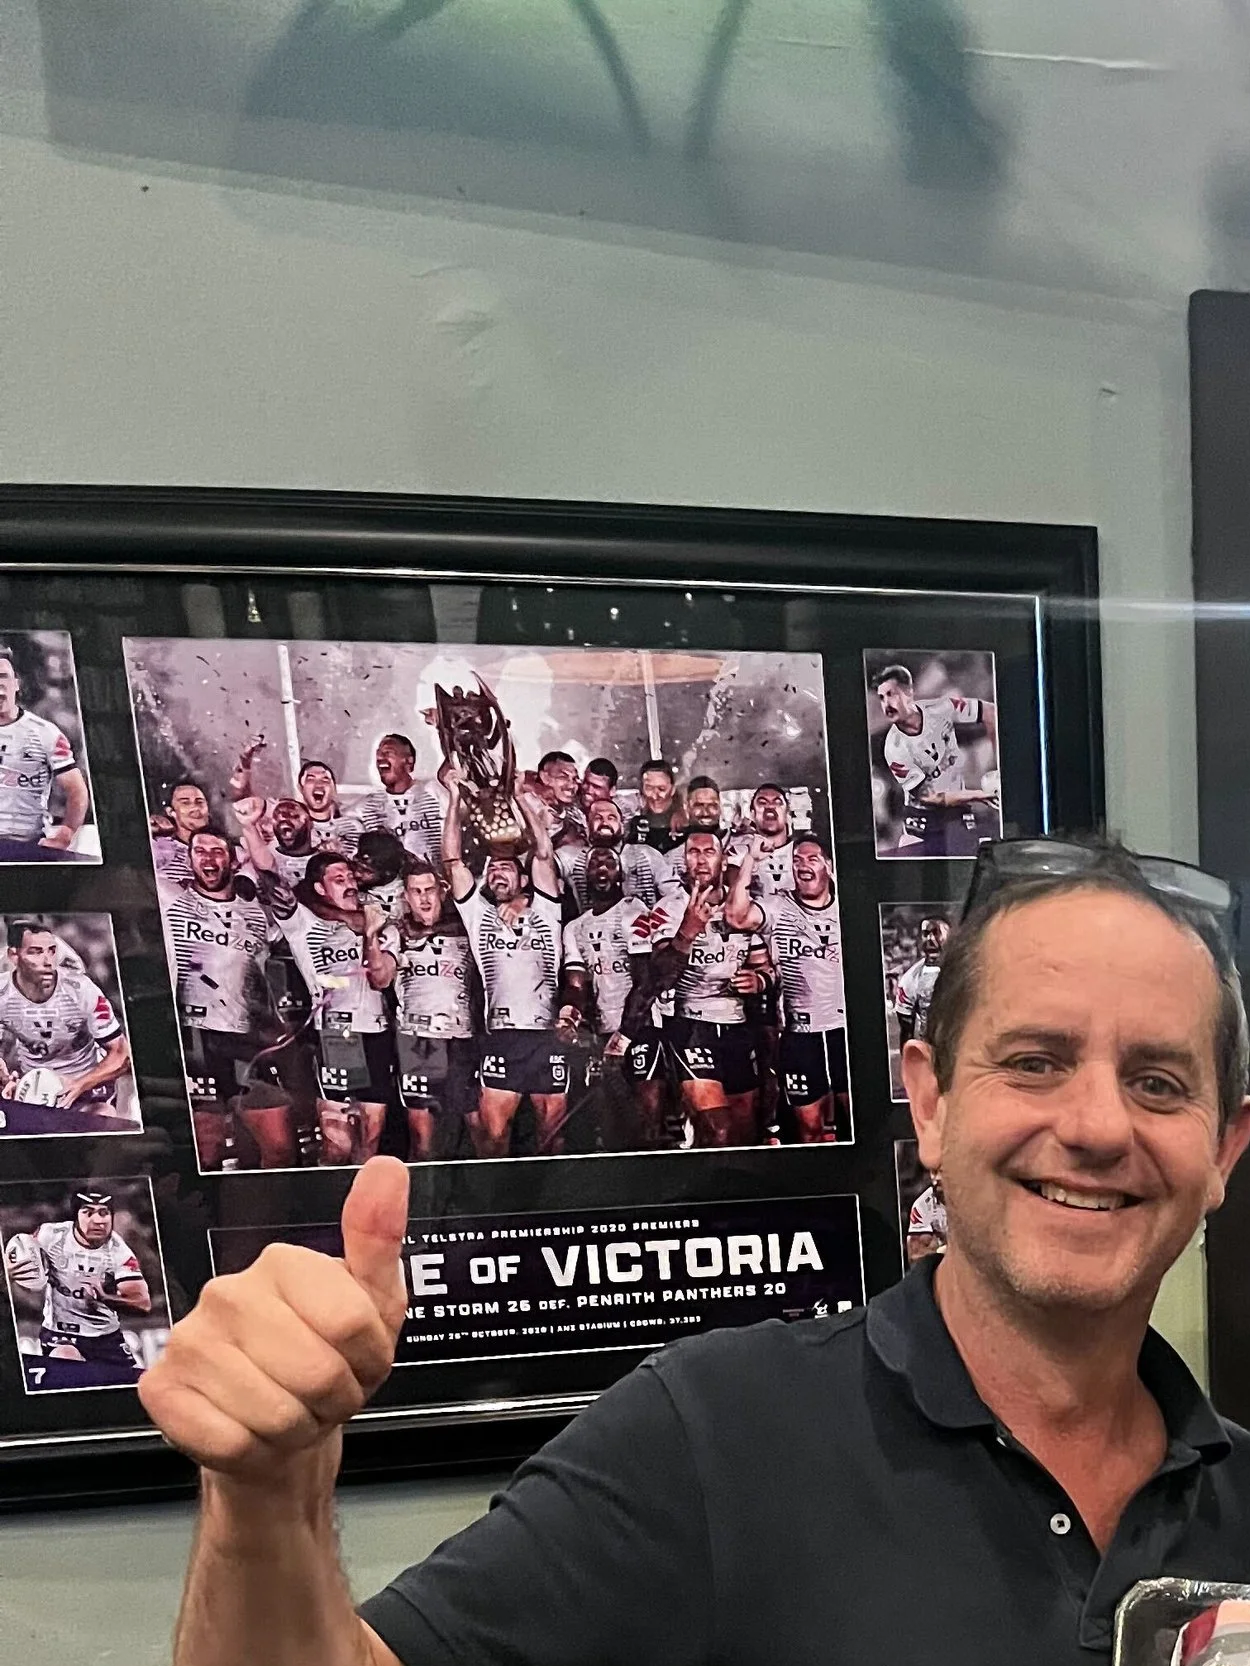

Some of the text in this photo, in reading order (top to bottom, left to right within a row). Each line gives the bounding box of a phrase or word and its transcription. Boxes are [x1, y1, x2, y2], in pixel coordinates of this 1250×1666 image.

[421, 1231, 485, 1244] TELSTRA
[491, 1225, 585, 1239] PREMIERSHIP
[590, 1222, 627, 1234] 2020
[632, 1219, 700, 1231] PREMIERS
[402, 1231, 825, 1295] E OF VICTORIA
[434, 1301, 500, 1319] STORM
[507, 1299, 531, 1313] 26
[538, 1298, 571, 1311] DEF.
[577, 1291, 655, 1308] PENRITH
[662, 1284, 757, 1302] PANTHERS
[763, 1282, 787, 1296] 20
[406, 1333, 445, 1343] SUNDAY
[579, 1321, 621, 1331] STADIUM
[28, 1367, 47, 1385] 7
